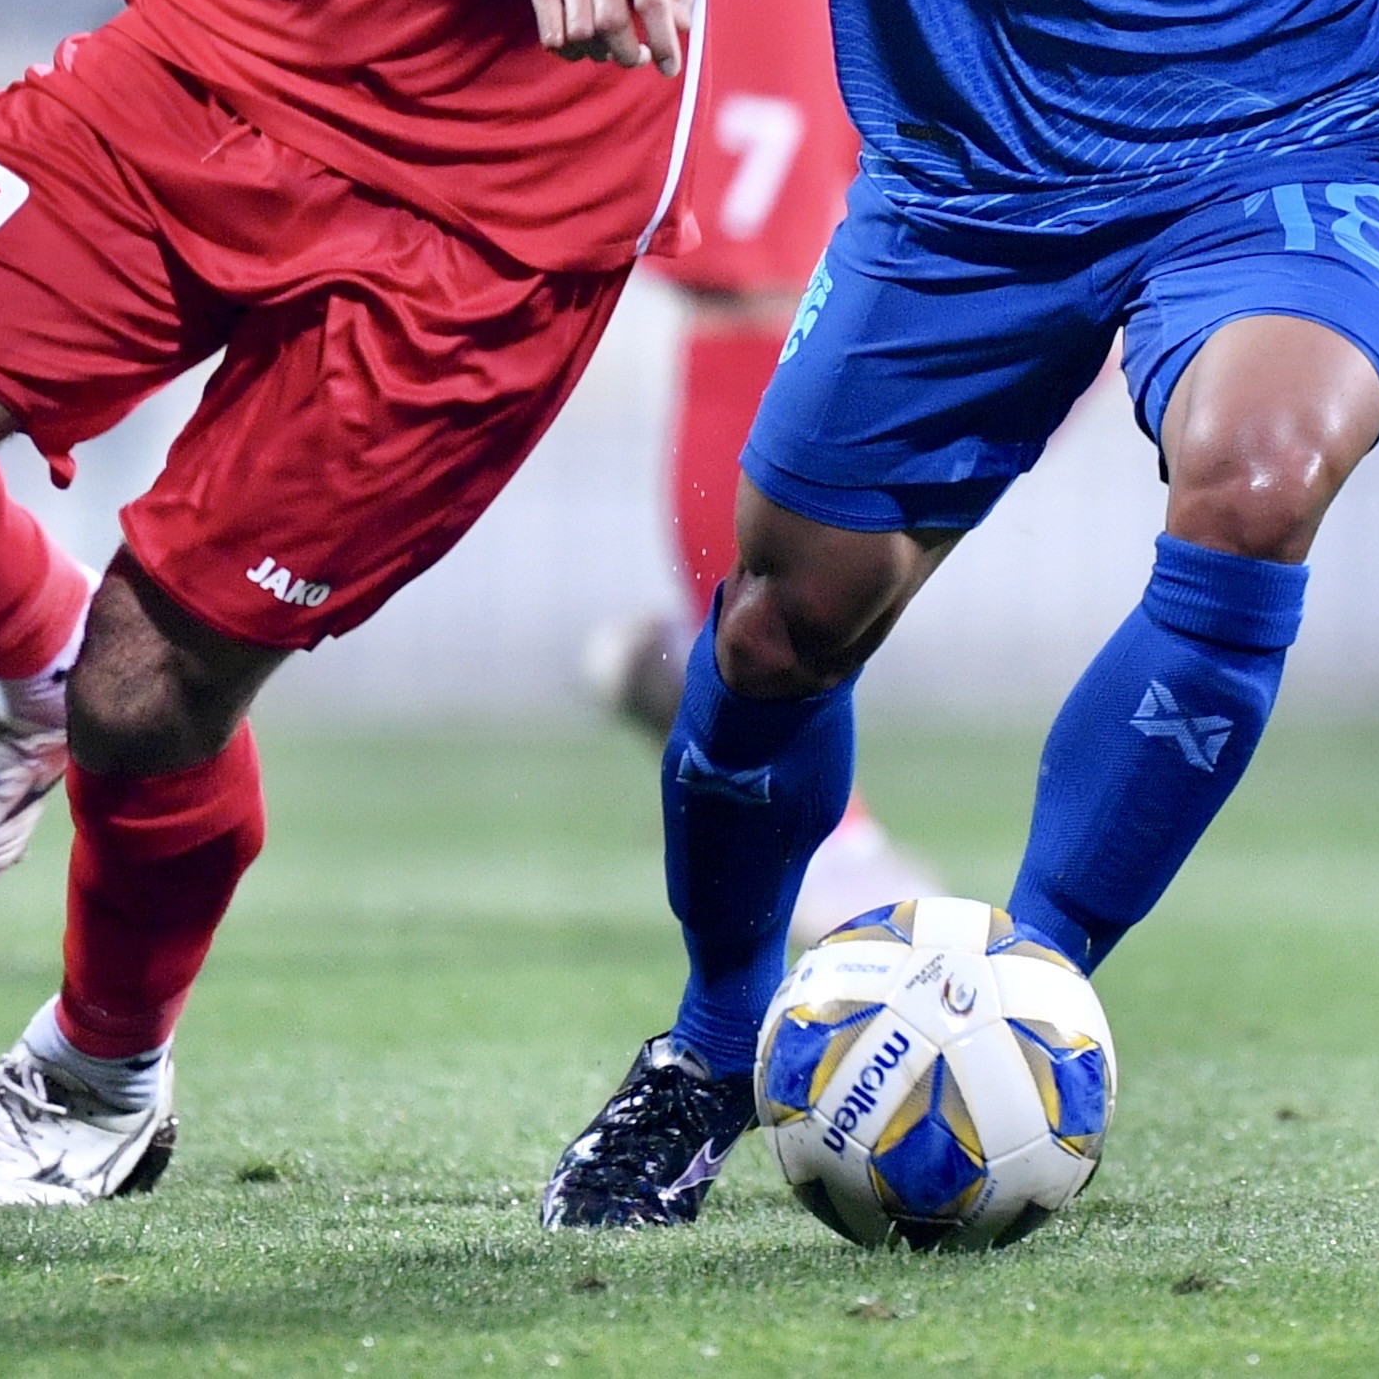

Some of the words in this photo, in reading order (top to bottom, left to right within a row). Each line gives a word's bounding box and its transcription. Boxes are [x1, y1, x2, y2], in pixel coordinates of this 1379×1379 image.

[716, 93, 807, 241] 7
[246, 556, 331, 608] JAKO
[822, 1030, 910, 1154] molten
